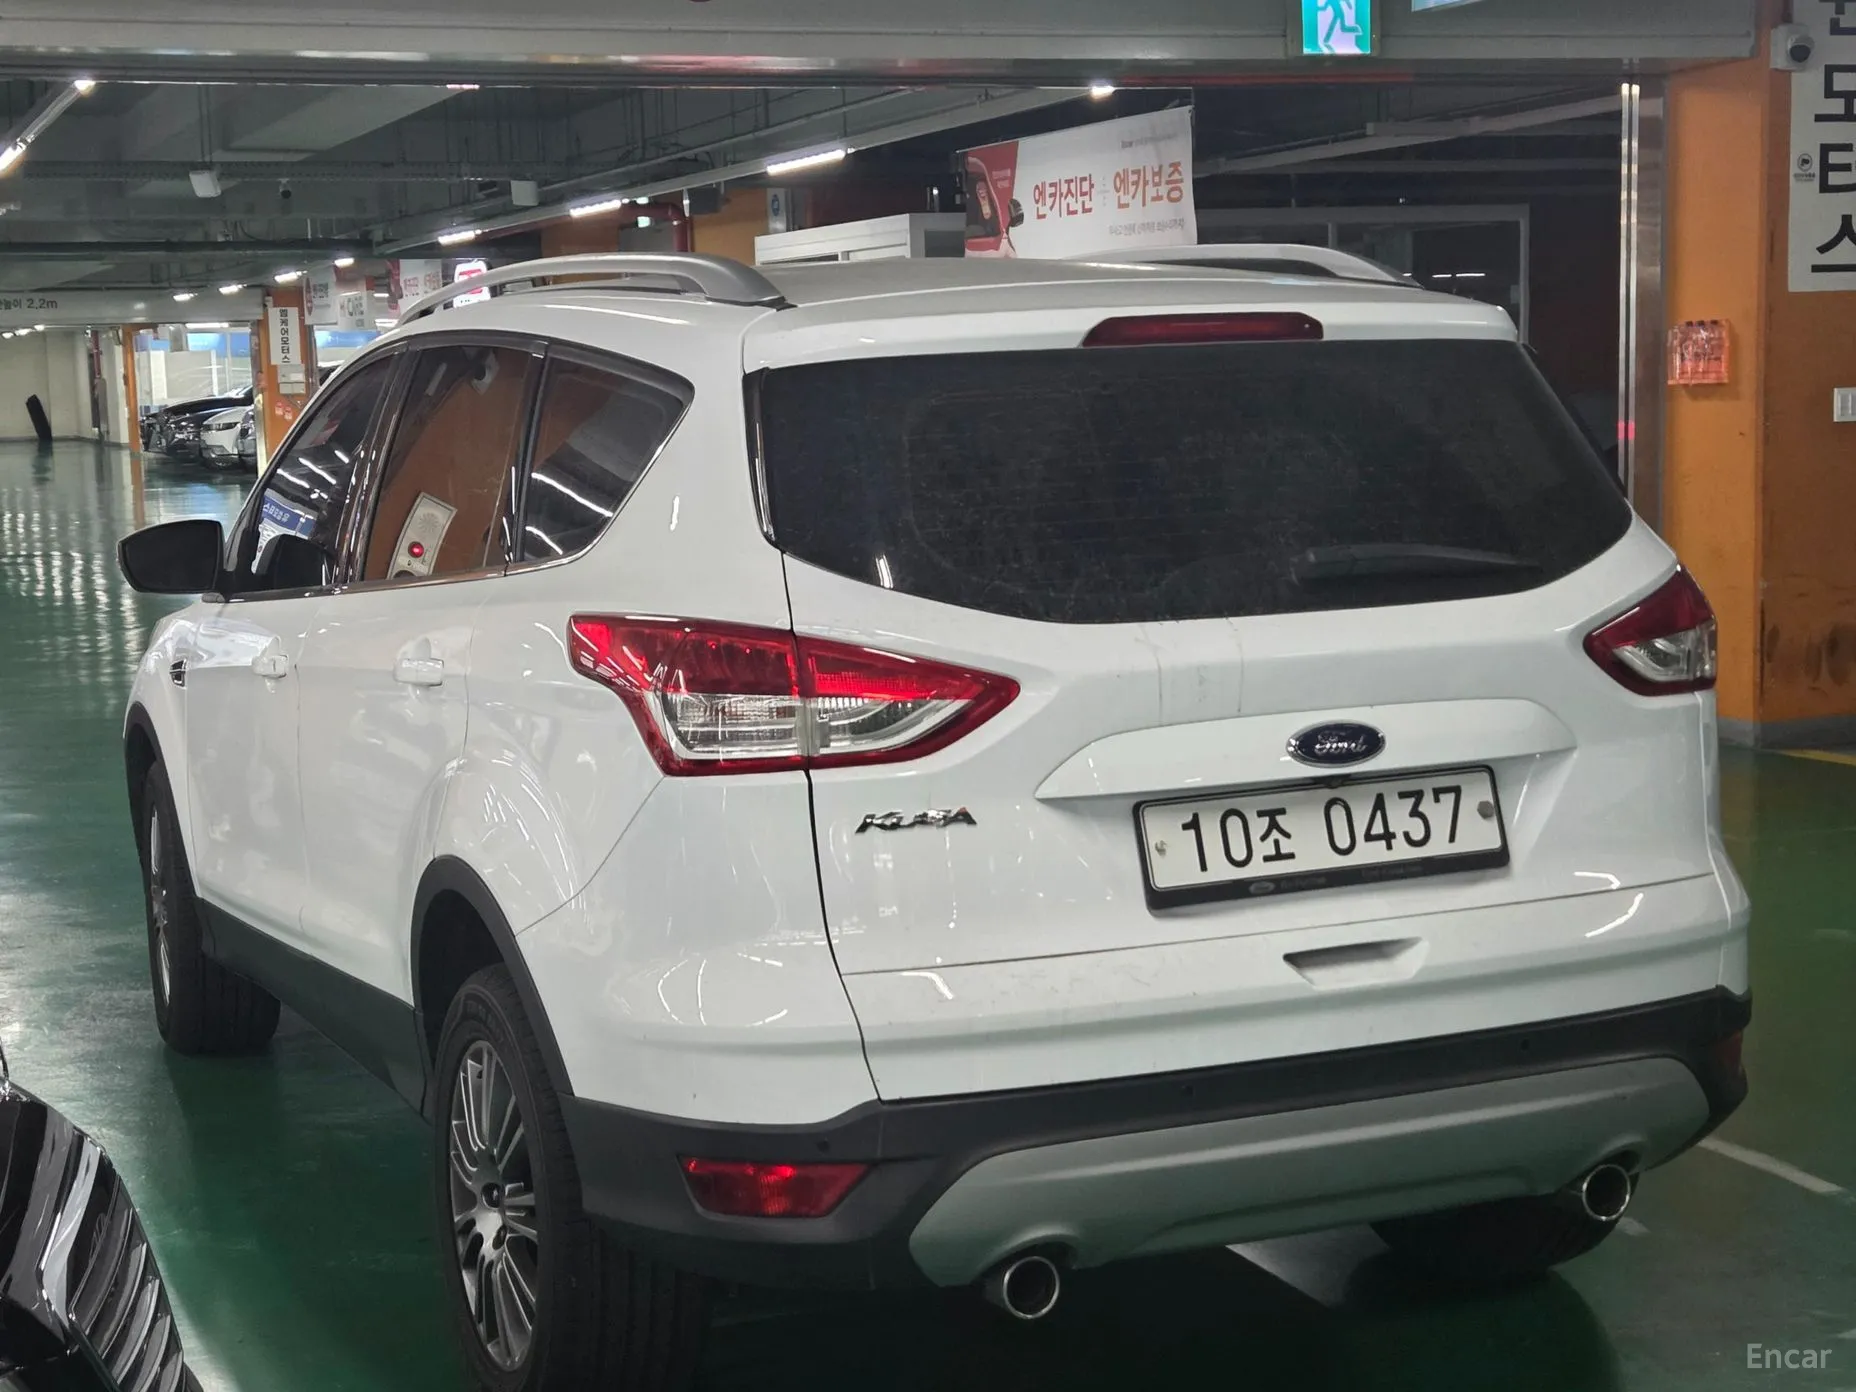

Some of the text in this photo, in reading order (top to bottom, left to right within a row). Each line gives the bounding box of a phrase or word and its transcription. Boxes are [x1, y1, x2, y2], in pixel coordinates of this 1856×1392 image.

[1032, 173, 1095, 220] 엔카진단
[1113, 161, 1185, 210] 엔카보증
[1314, 731, 1367, 756] Ford
[1180, 785, 1463, 873] 10조 0437
